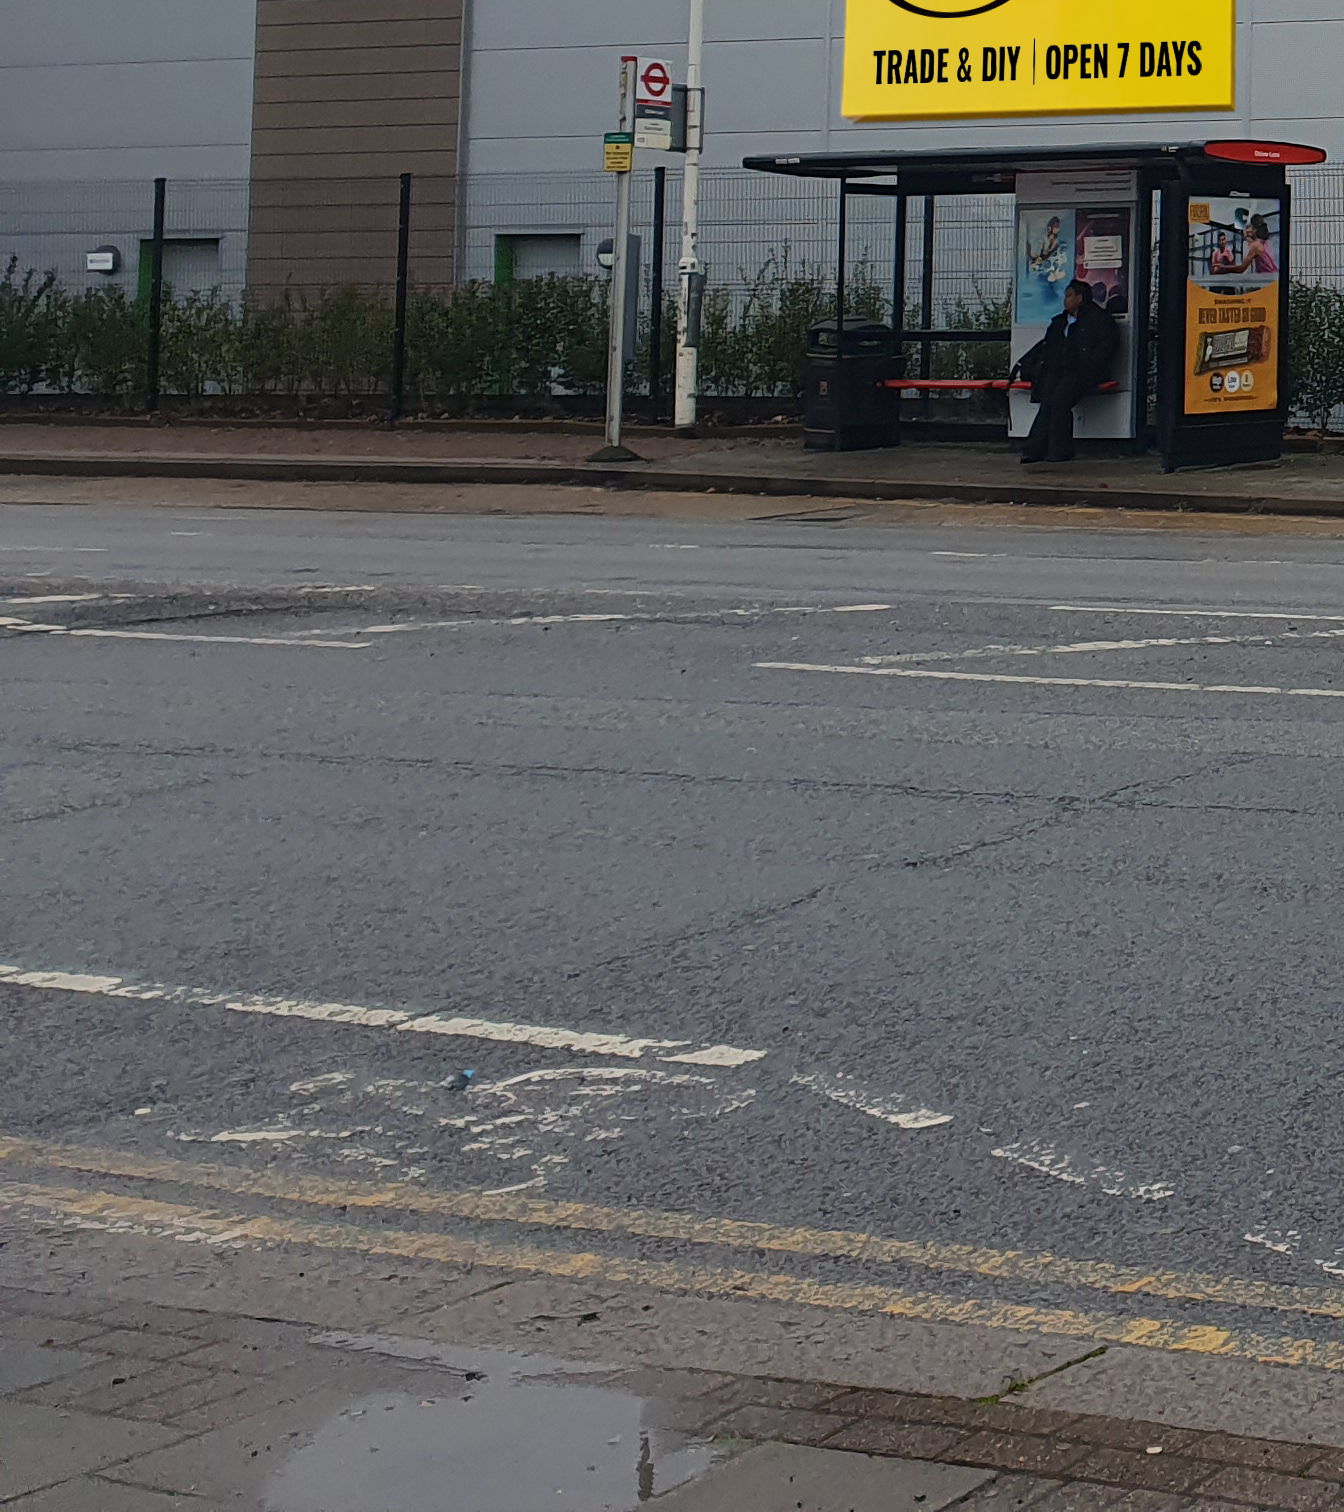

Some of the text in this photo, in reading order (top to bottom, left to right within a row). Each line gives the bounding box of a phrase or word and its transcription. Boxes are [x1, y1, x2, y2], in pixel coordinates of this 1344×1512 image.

[874, 41, 1202, 85] TRADE & DIY OPEN 7 DAYS
